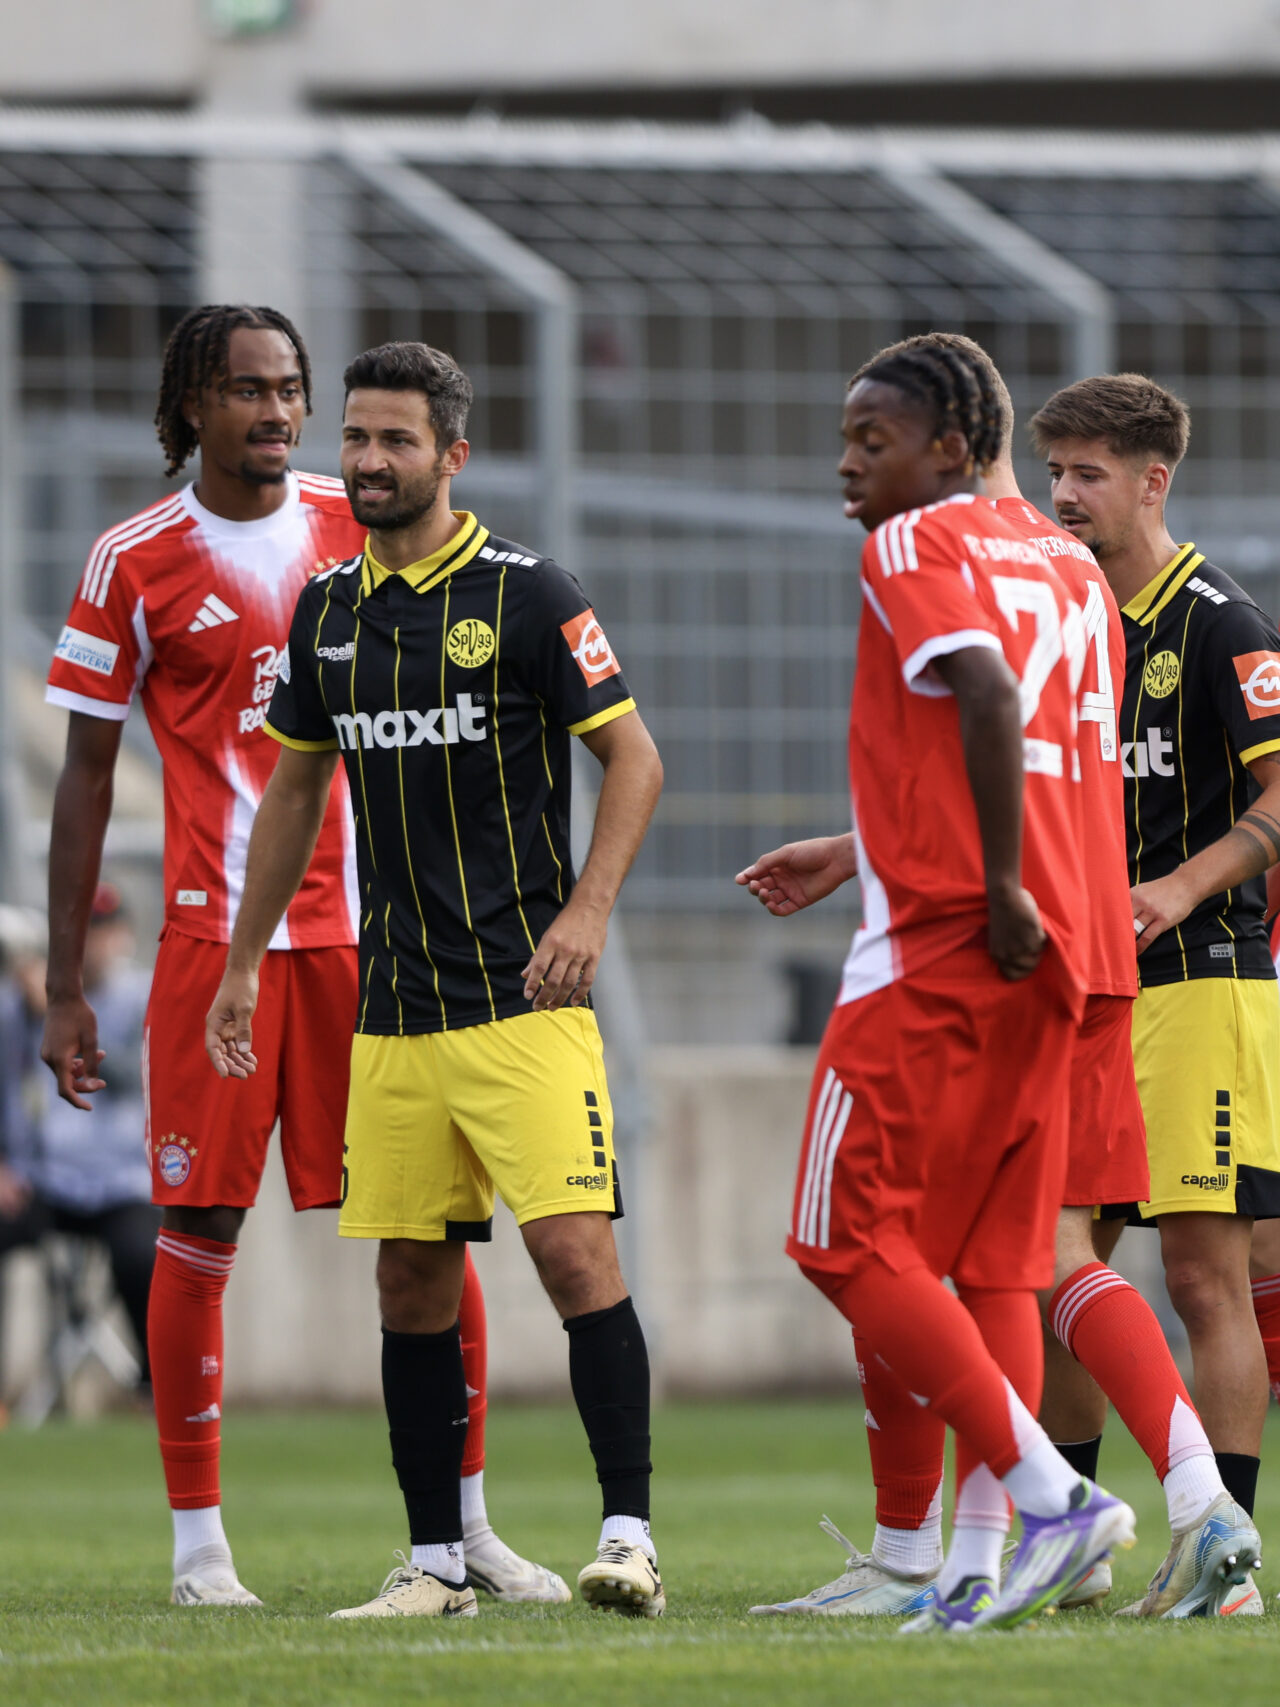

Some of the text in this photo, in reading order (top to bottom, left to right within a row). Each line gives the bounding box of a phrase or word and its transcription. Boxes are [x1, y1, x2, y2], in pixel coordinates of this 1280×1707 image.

[317, 642, 355, 660] capelli
[451, 650, 490, 667] BAYREUTH
[68, 648, 112, 672] BAYERN
[1146, 680, 1175, 697] BAYREUTH
[332, 693, 487, 750] maxit
[566, 1172, 608, 1189] capelli
[1181, 1173, 1229, 1189] capelli
